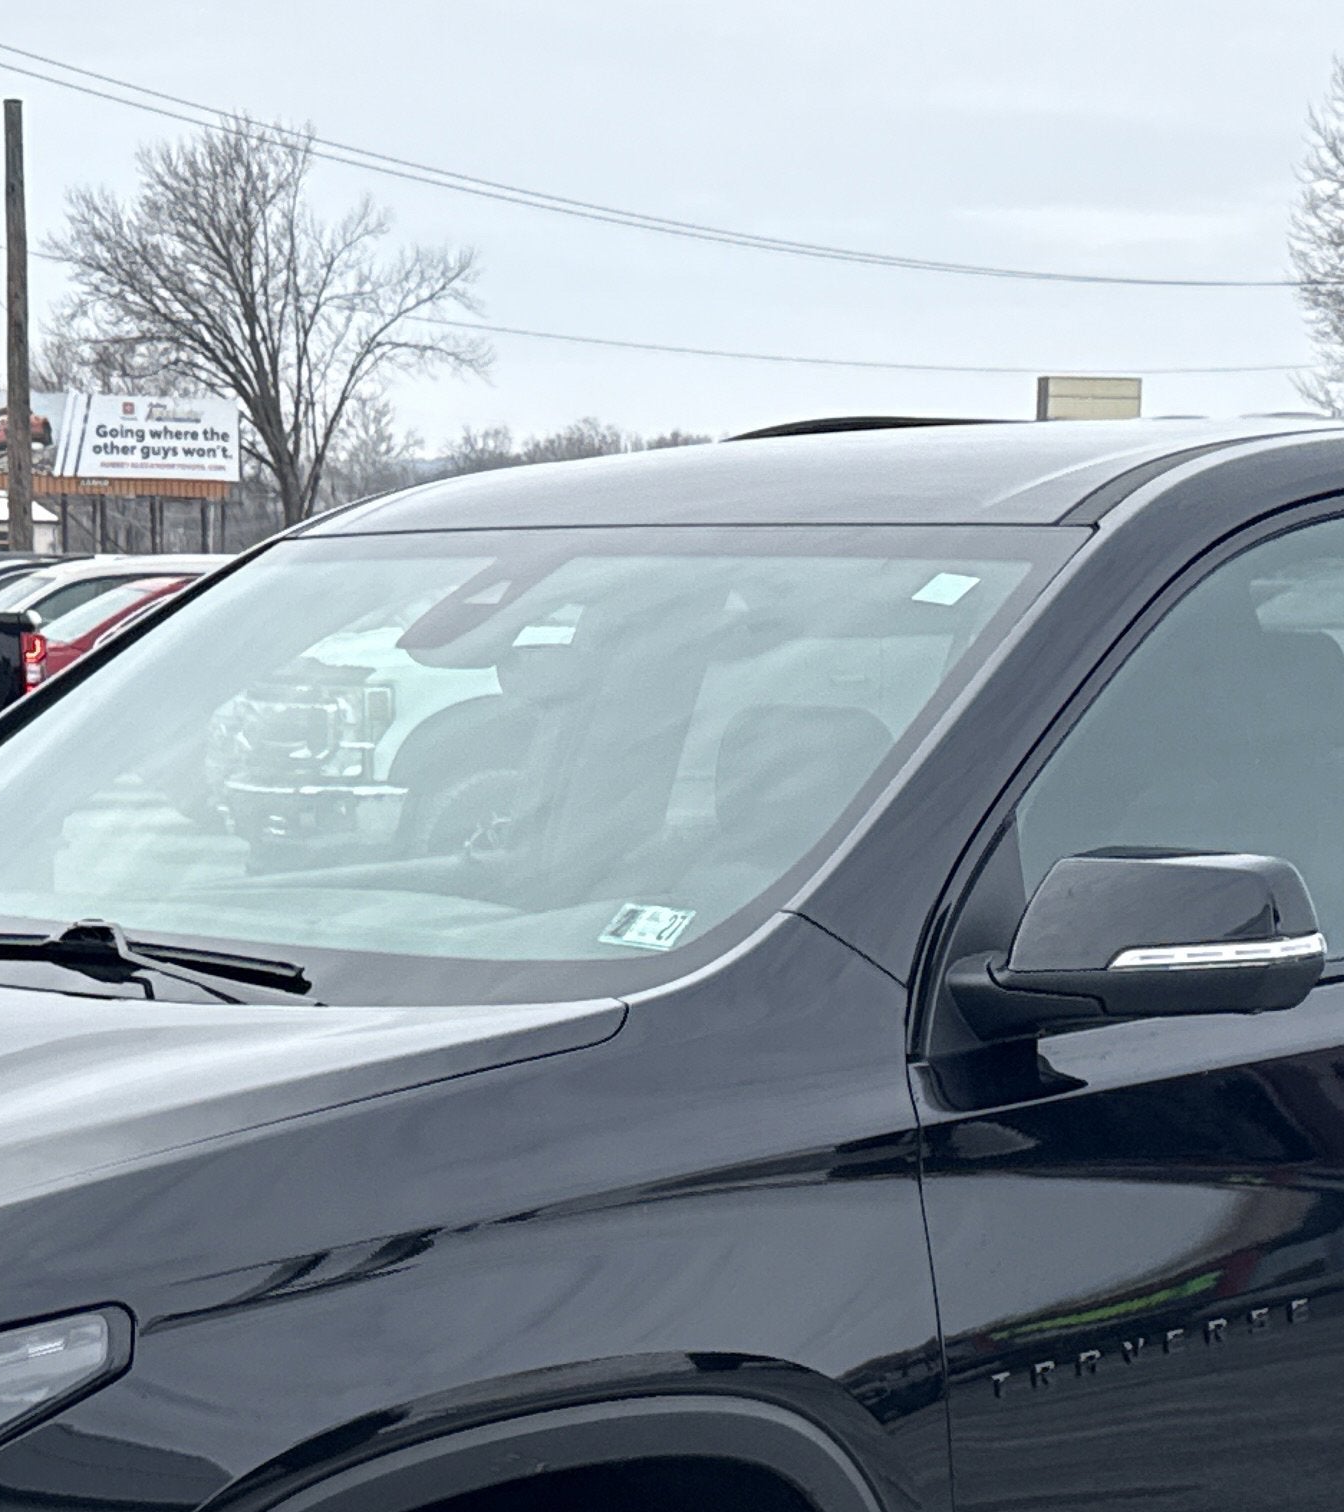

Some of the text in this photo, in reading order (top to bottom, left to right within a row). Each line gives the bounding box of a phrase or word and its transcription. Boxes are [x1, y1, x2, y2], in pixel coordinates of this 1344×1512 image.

[95, 424, 230, 442] Going where the
[92, 441, 233, 460] other guys won't.
[655, 913, 688, 941] 27
[992, 1298, 1310, 1399] TRAVERSE
